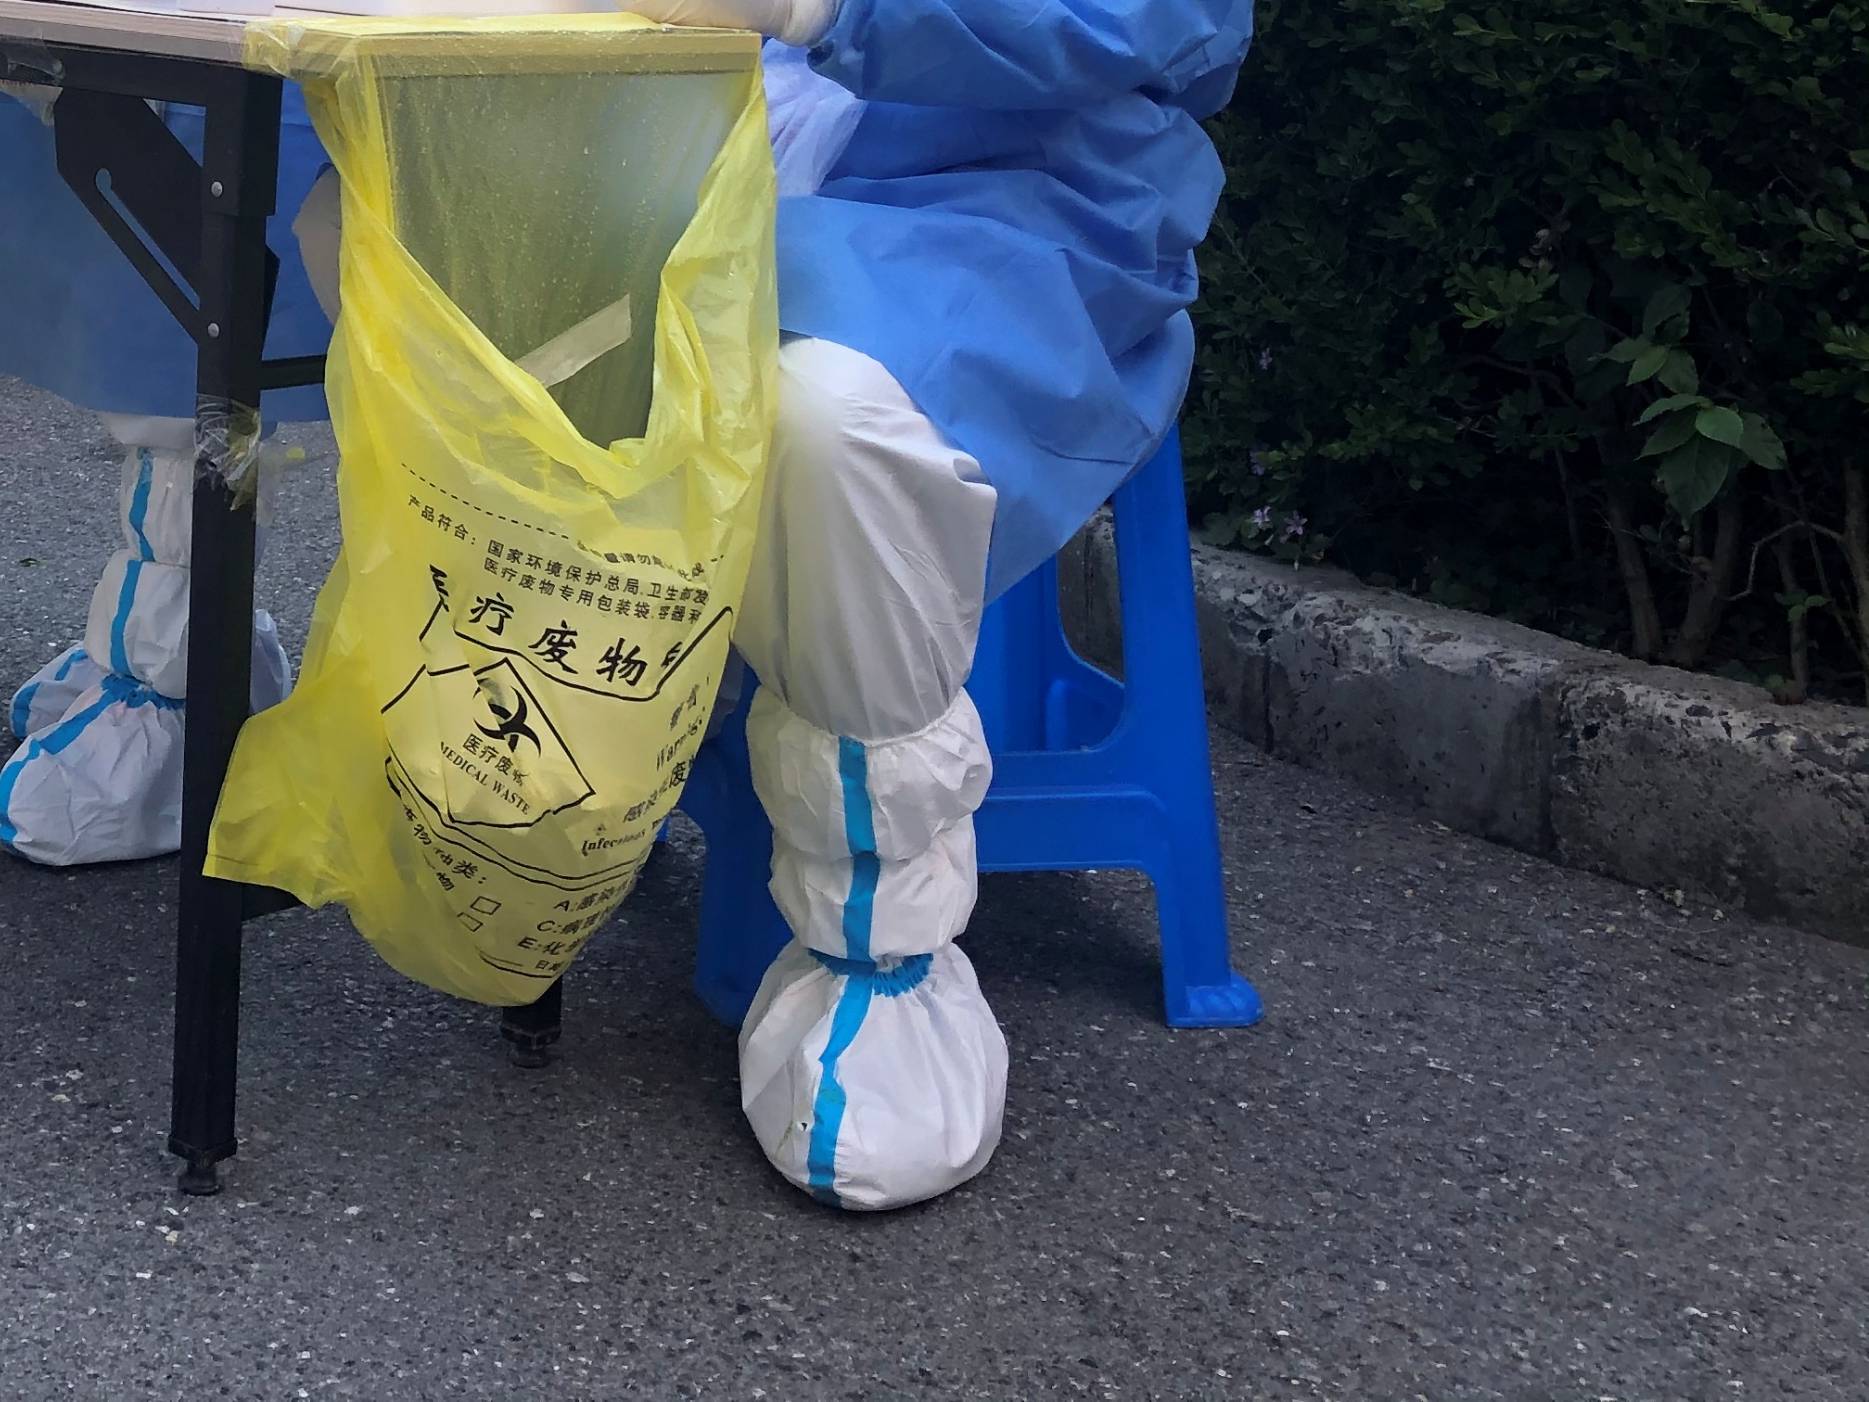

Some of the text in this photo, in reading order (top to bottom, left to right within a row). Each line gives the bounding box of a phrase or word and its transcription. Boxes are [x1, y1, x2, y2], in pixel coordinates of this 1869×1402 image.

[461, 732, 531, 788] 医疗废物
[491, 779, 531, 816] WASTE
